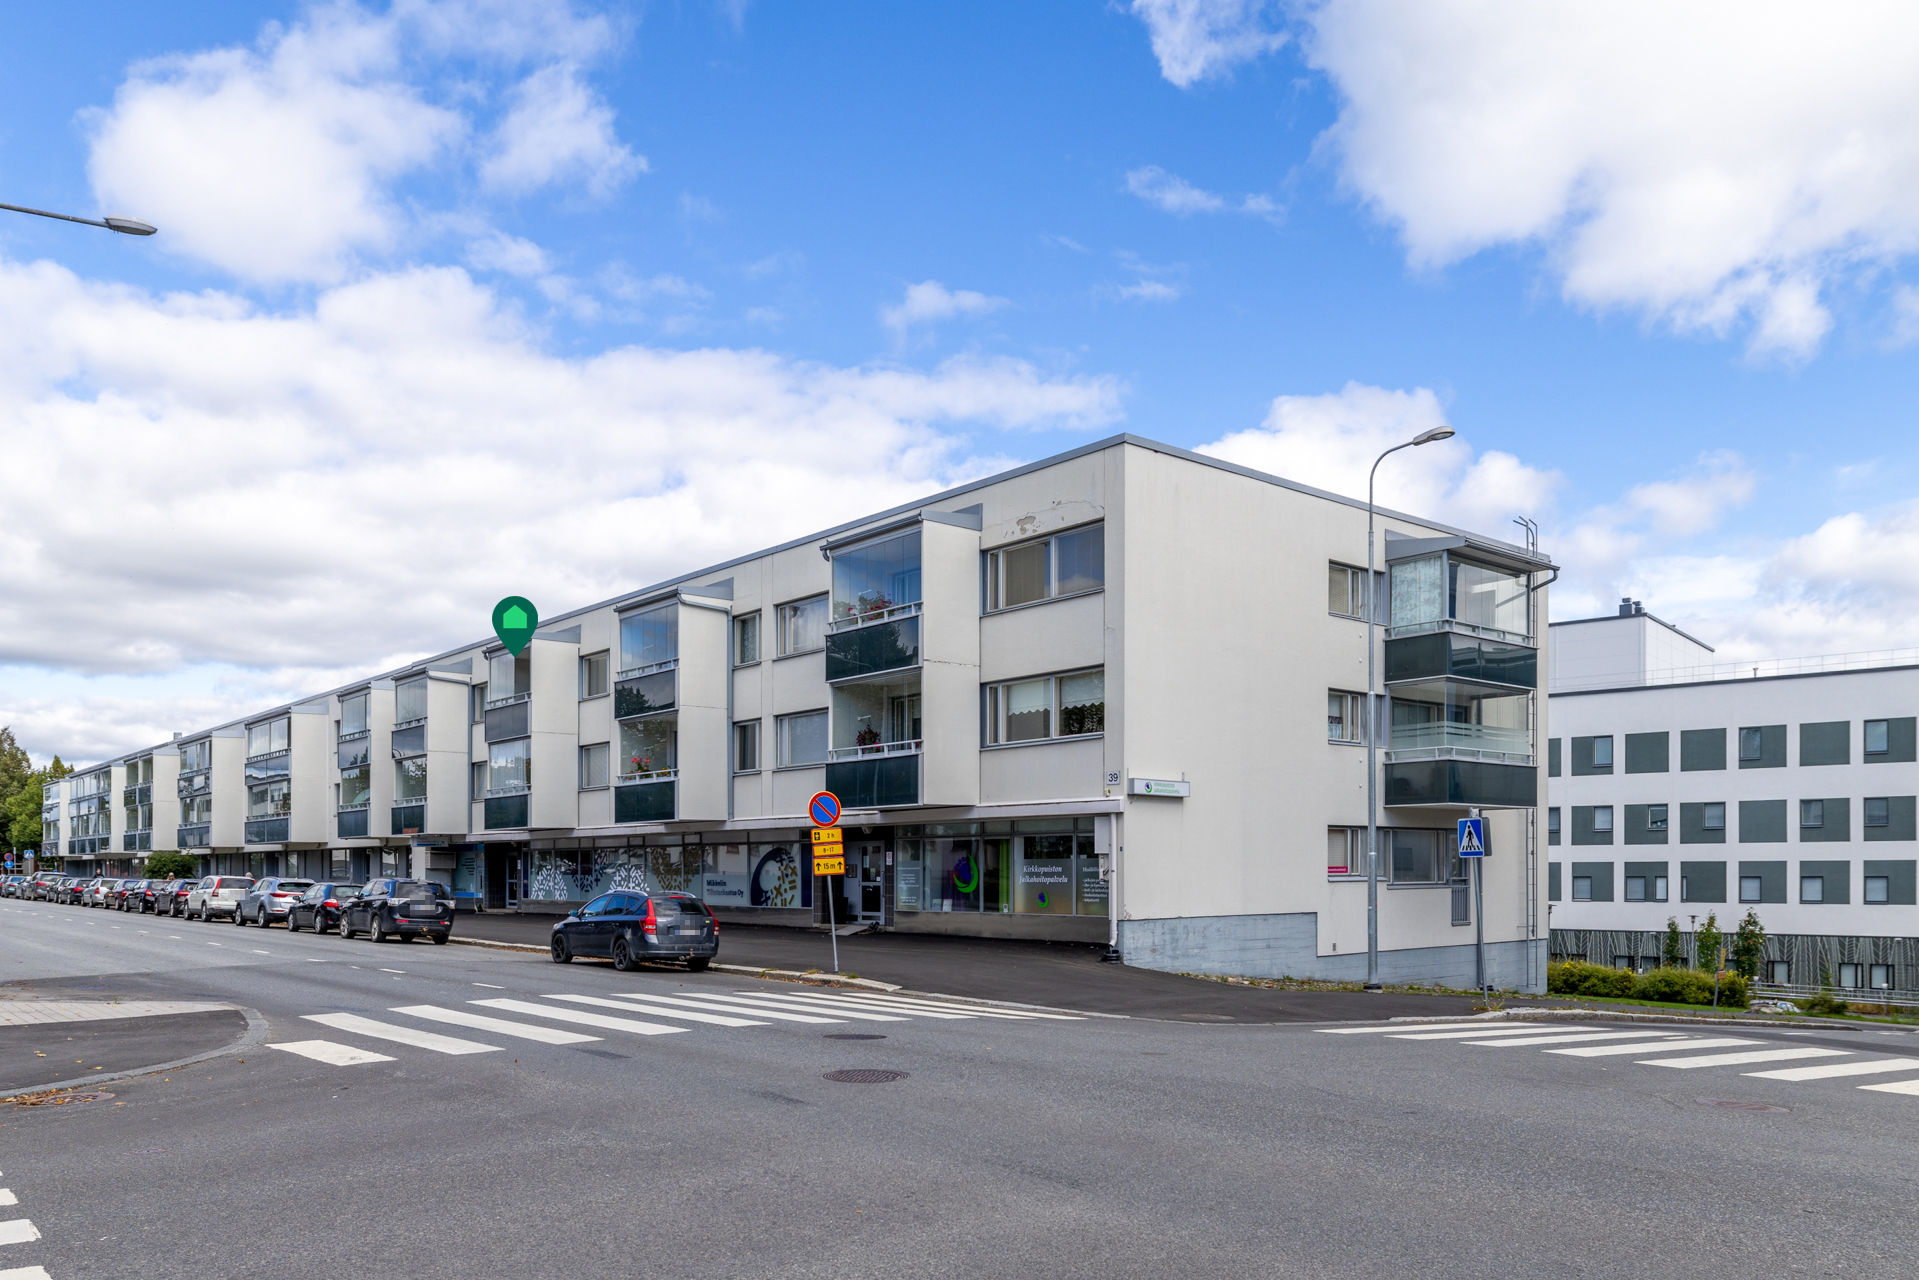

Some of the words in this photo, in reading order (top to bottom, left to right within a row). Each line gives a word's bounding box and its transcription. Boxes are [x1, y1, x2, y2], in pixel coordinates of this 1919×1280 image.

[1108, 772, 1119, 782] 39
[823, 862, 830, 870] 15
[1023, 864, 1063, 874] Kirkkopuiston
[1019, 875, 1068, 885] Jalkahoitopalvelu
[738, 889, 744, 898] Oy
